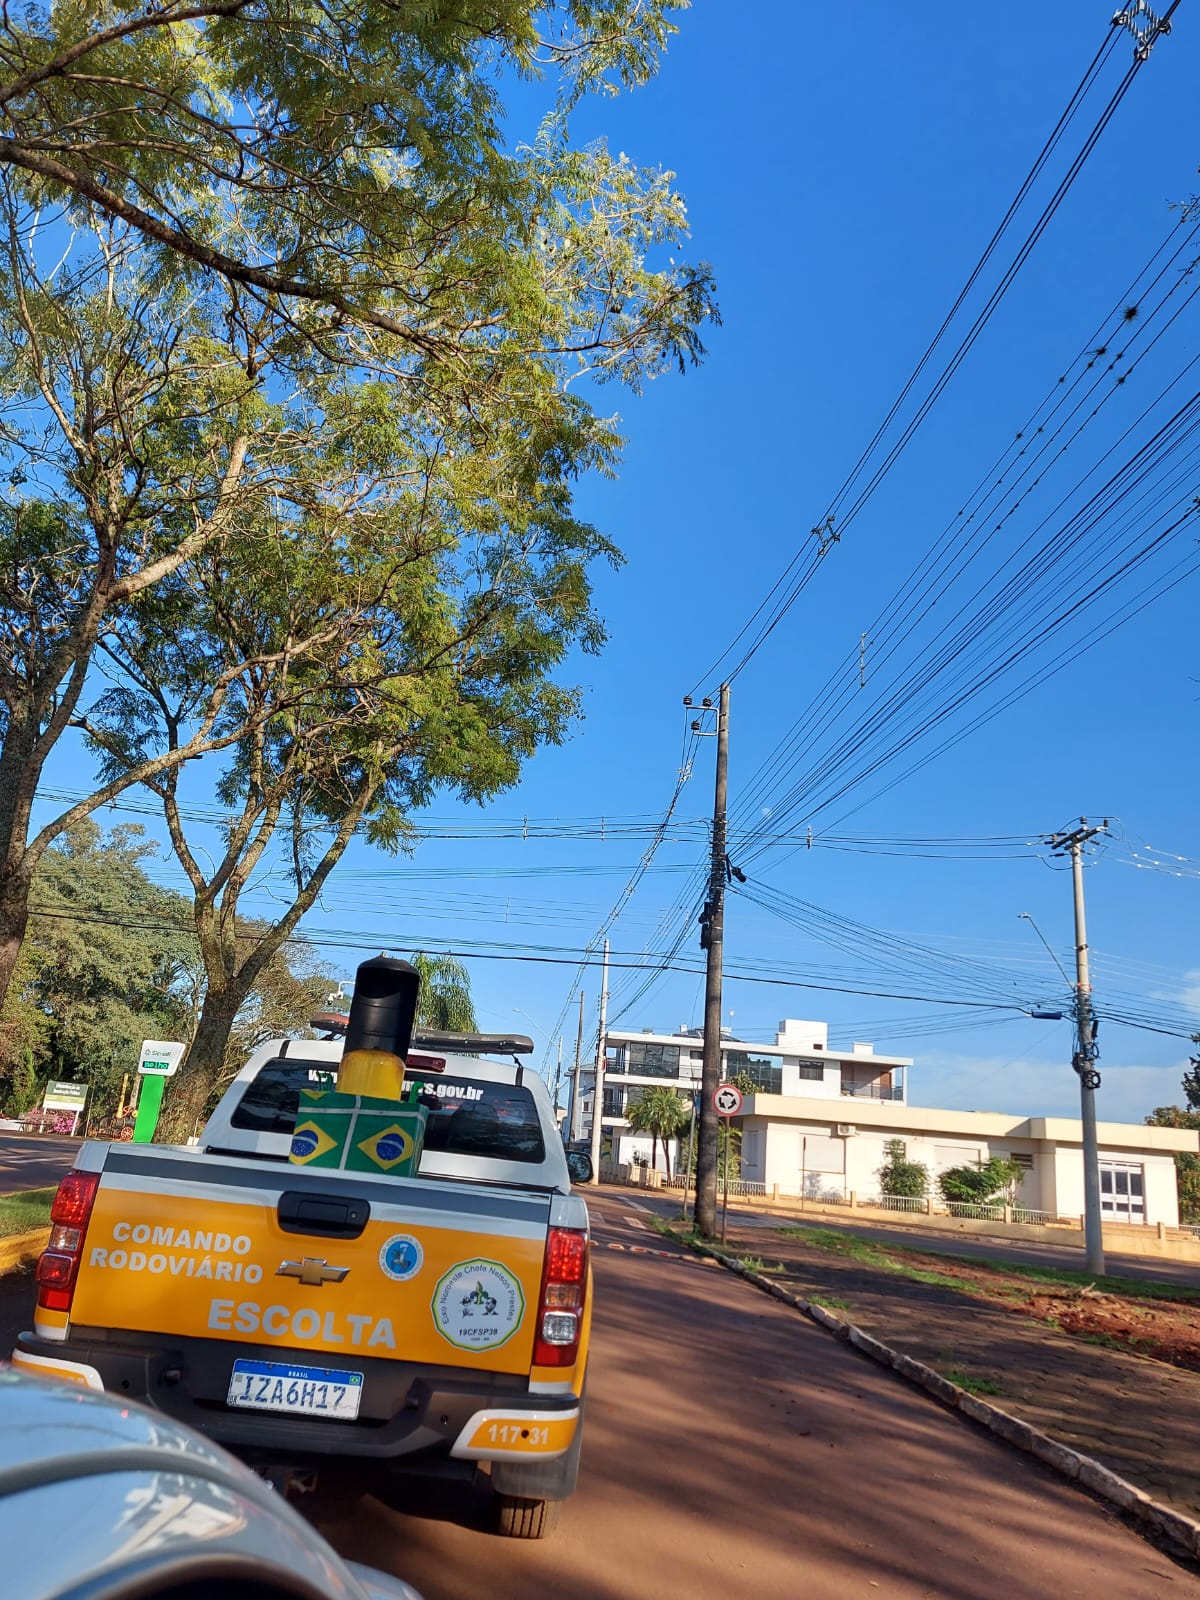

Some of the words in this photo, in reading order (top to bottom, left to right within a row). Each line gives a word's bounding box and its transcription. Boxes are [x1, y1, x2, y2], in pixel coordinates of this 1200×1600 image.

[113, 1222, 252, 1255] COMANDO
[89, 1247, 263, 1284] RODOVIÁRIO
[440, 1271, 463, 1304] Noroeste
[464, 1264, 487, 1274] Chefe
[489, 1267, 511, 1289] Nelson
[506, 1289, 516, 1321] Prestes
[207, 1298, 397, 1349] ESCOLTA
[239, 1375, 347, 1411] IZA6H17
